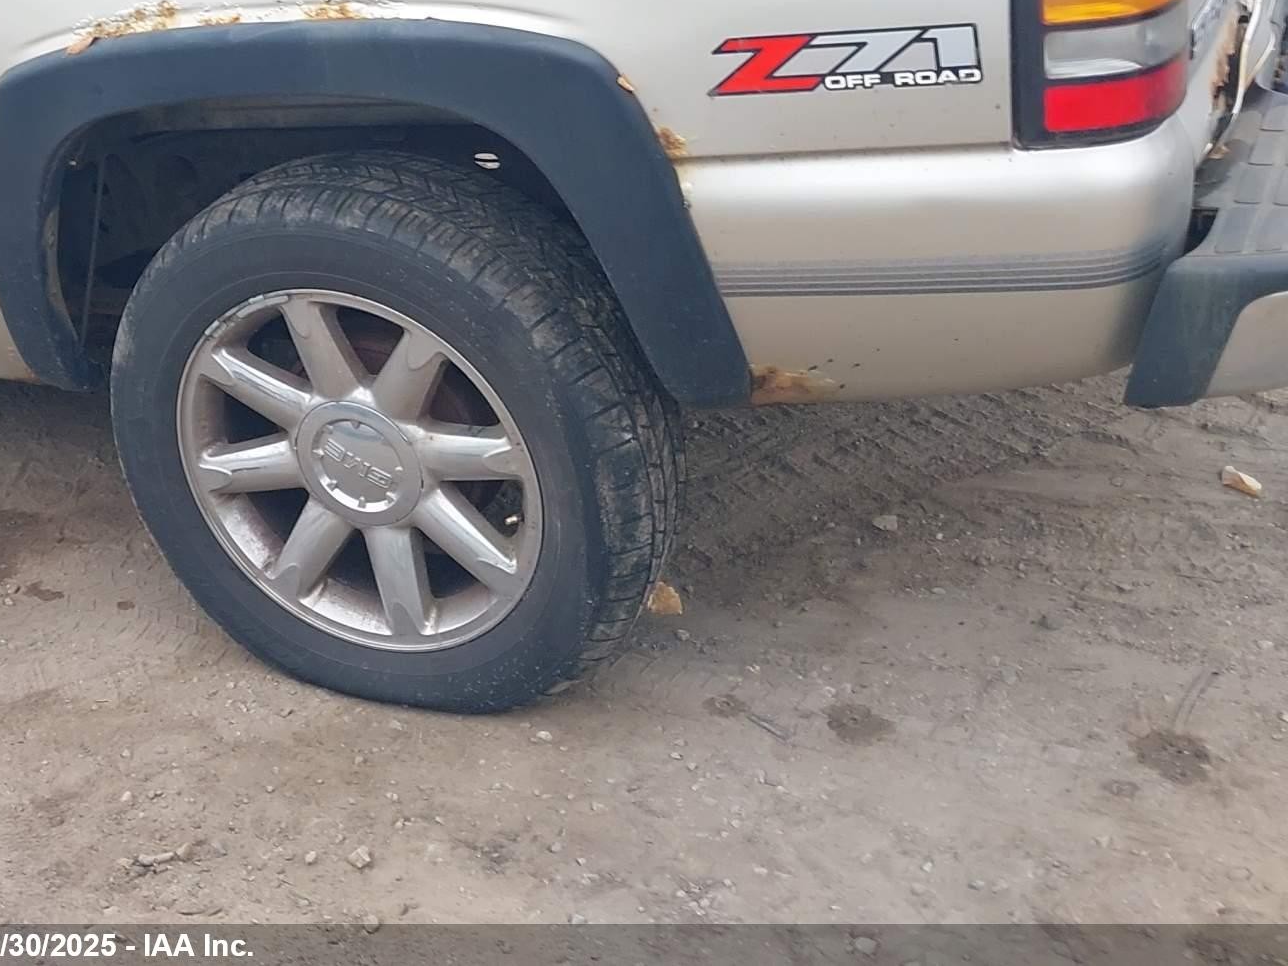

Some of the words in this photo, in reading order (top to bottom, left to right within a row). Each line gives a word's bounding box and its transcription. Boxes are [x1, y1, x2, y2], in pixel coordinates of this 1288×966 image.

[707, 22, 982, 97] Z71
[824, 72, 881, 90] OFF
[894, 67, 981, 87] ROAD
